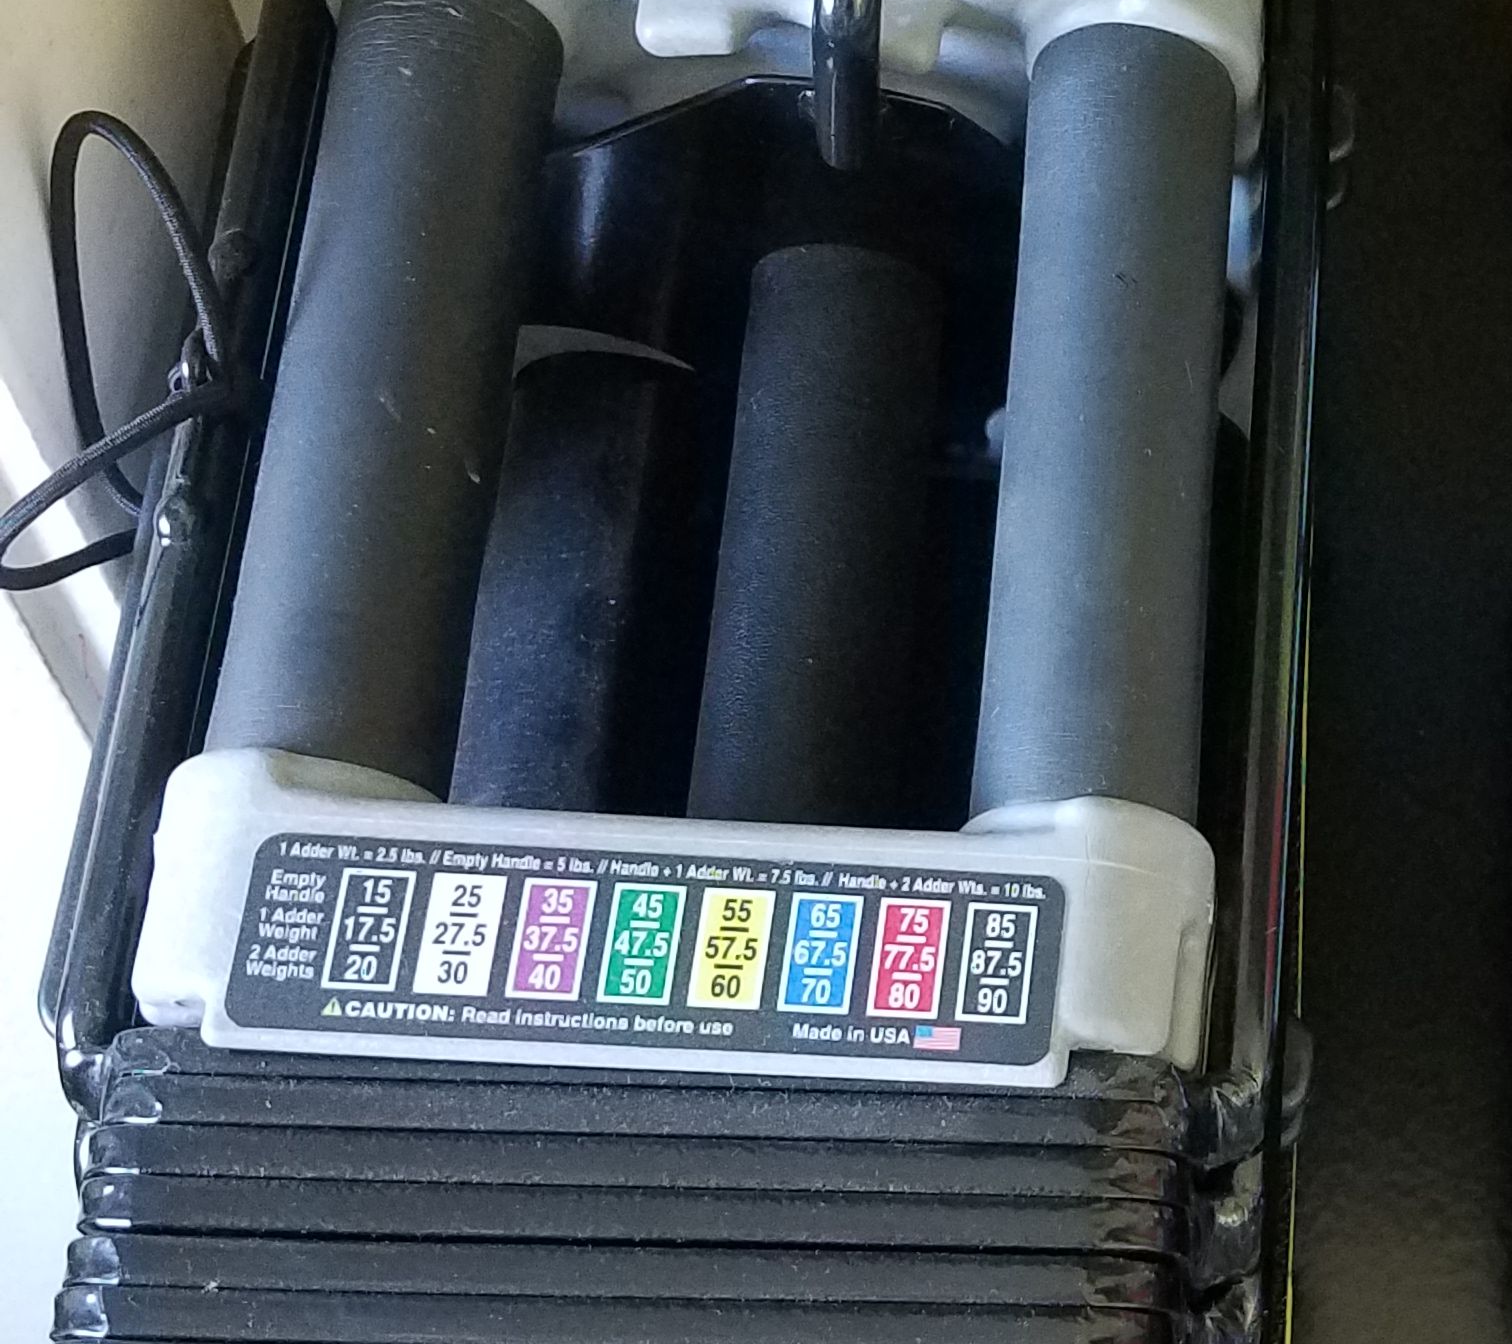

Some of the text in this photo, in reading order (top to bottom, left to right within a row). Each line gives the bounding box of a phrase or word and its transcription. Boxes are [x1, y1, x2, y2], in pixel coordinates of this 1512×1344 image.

[271, 868, 327, 889] Empty
[280, 842, 286, 856] 1
[290, 843, 334, 859] Adder
[375, 846, 398, 862] 2.5
[400, 848, 426, 864] lbs.
[442, 850, 488, 871] Empty
[491, 853, 540, 871] Handle
[557, 858, 565, 871] 5
[569, 857, 594, 873] lbs.
[610, 859, 659, 877] Handle
[676, 864, 682, 878] 1
[686, 866, 729, 881] Adder
[770, 869, 791, 884] 7.5
[794, 870, 819, 886] lbs.
[838, 873, 886, 889] Handle
[902, 878, 911, 891] 2
[913, 878, 954, 894] Adder
[1004, 883, 1019, 897] 10
[1021, 884, 1046, 899] lbs.
[265, 885, 325, 904] Handle
[362, 878, 393, 904] 15
[452, 884, 483, 908] 25
[541, 888, 574, 914] 35
[259, 906, 325, 924] 1 Adder
[632, 893, 664, 918] 45
[722, 898, 753, 923] 55
[810, 903, 841, 928] 65
[258, 922, 318, 943] Weight
[344, 916, 397, 943] 17.5
[900, 907, 930, 933] 75
[986, 913, 1016, 938] 85
[432, 922, 487, 947] 27.5
[523, 926, 579, 953] 37.5
[614, 931, 669, 957] 47.5
[249, 944, 317, 963] 2 Adder
[705, 936, 758, 961] 57.5
[793, 940, 847, 966] 67.5
[884, 944, 935, 972] 77.5
[246, 959, 315, 981] Weights
[344, 955, 377, 981] 20
[437, 960, 468, 984] 30
[970, 950, 1022, 976] 87.5
[528, 964, 561, 990] 40
[619, 968, 651, 995] 50
[711, 974, 741, 998] 60
[802, 978, 832, 1004] 70
[888, 983, 920, 1009] 80
[977, 988, 1008, 1014] 90
[345, 1001, 733, 1035] CAUTION: Read instructions before use
[793, 1023, 910, 1045] Made in USA
